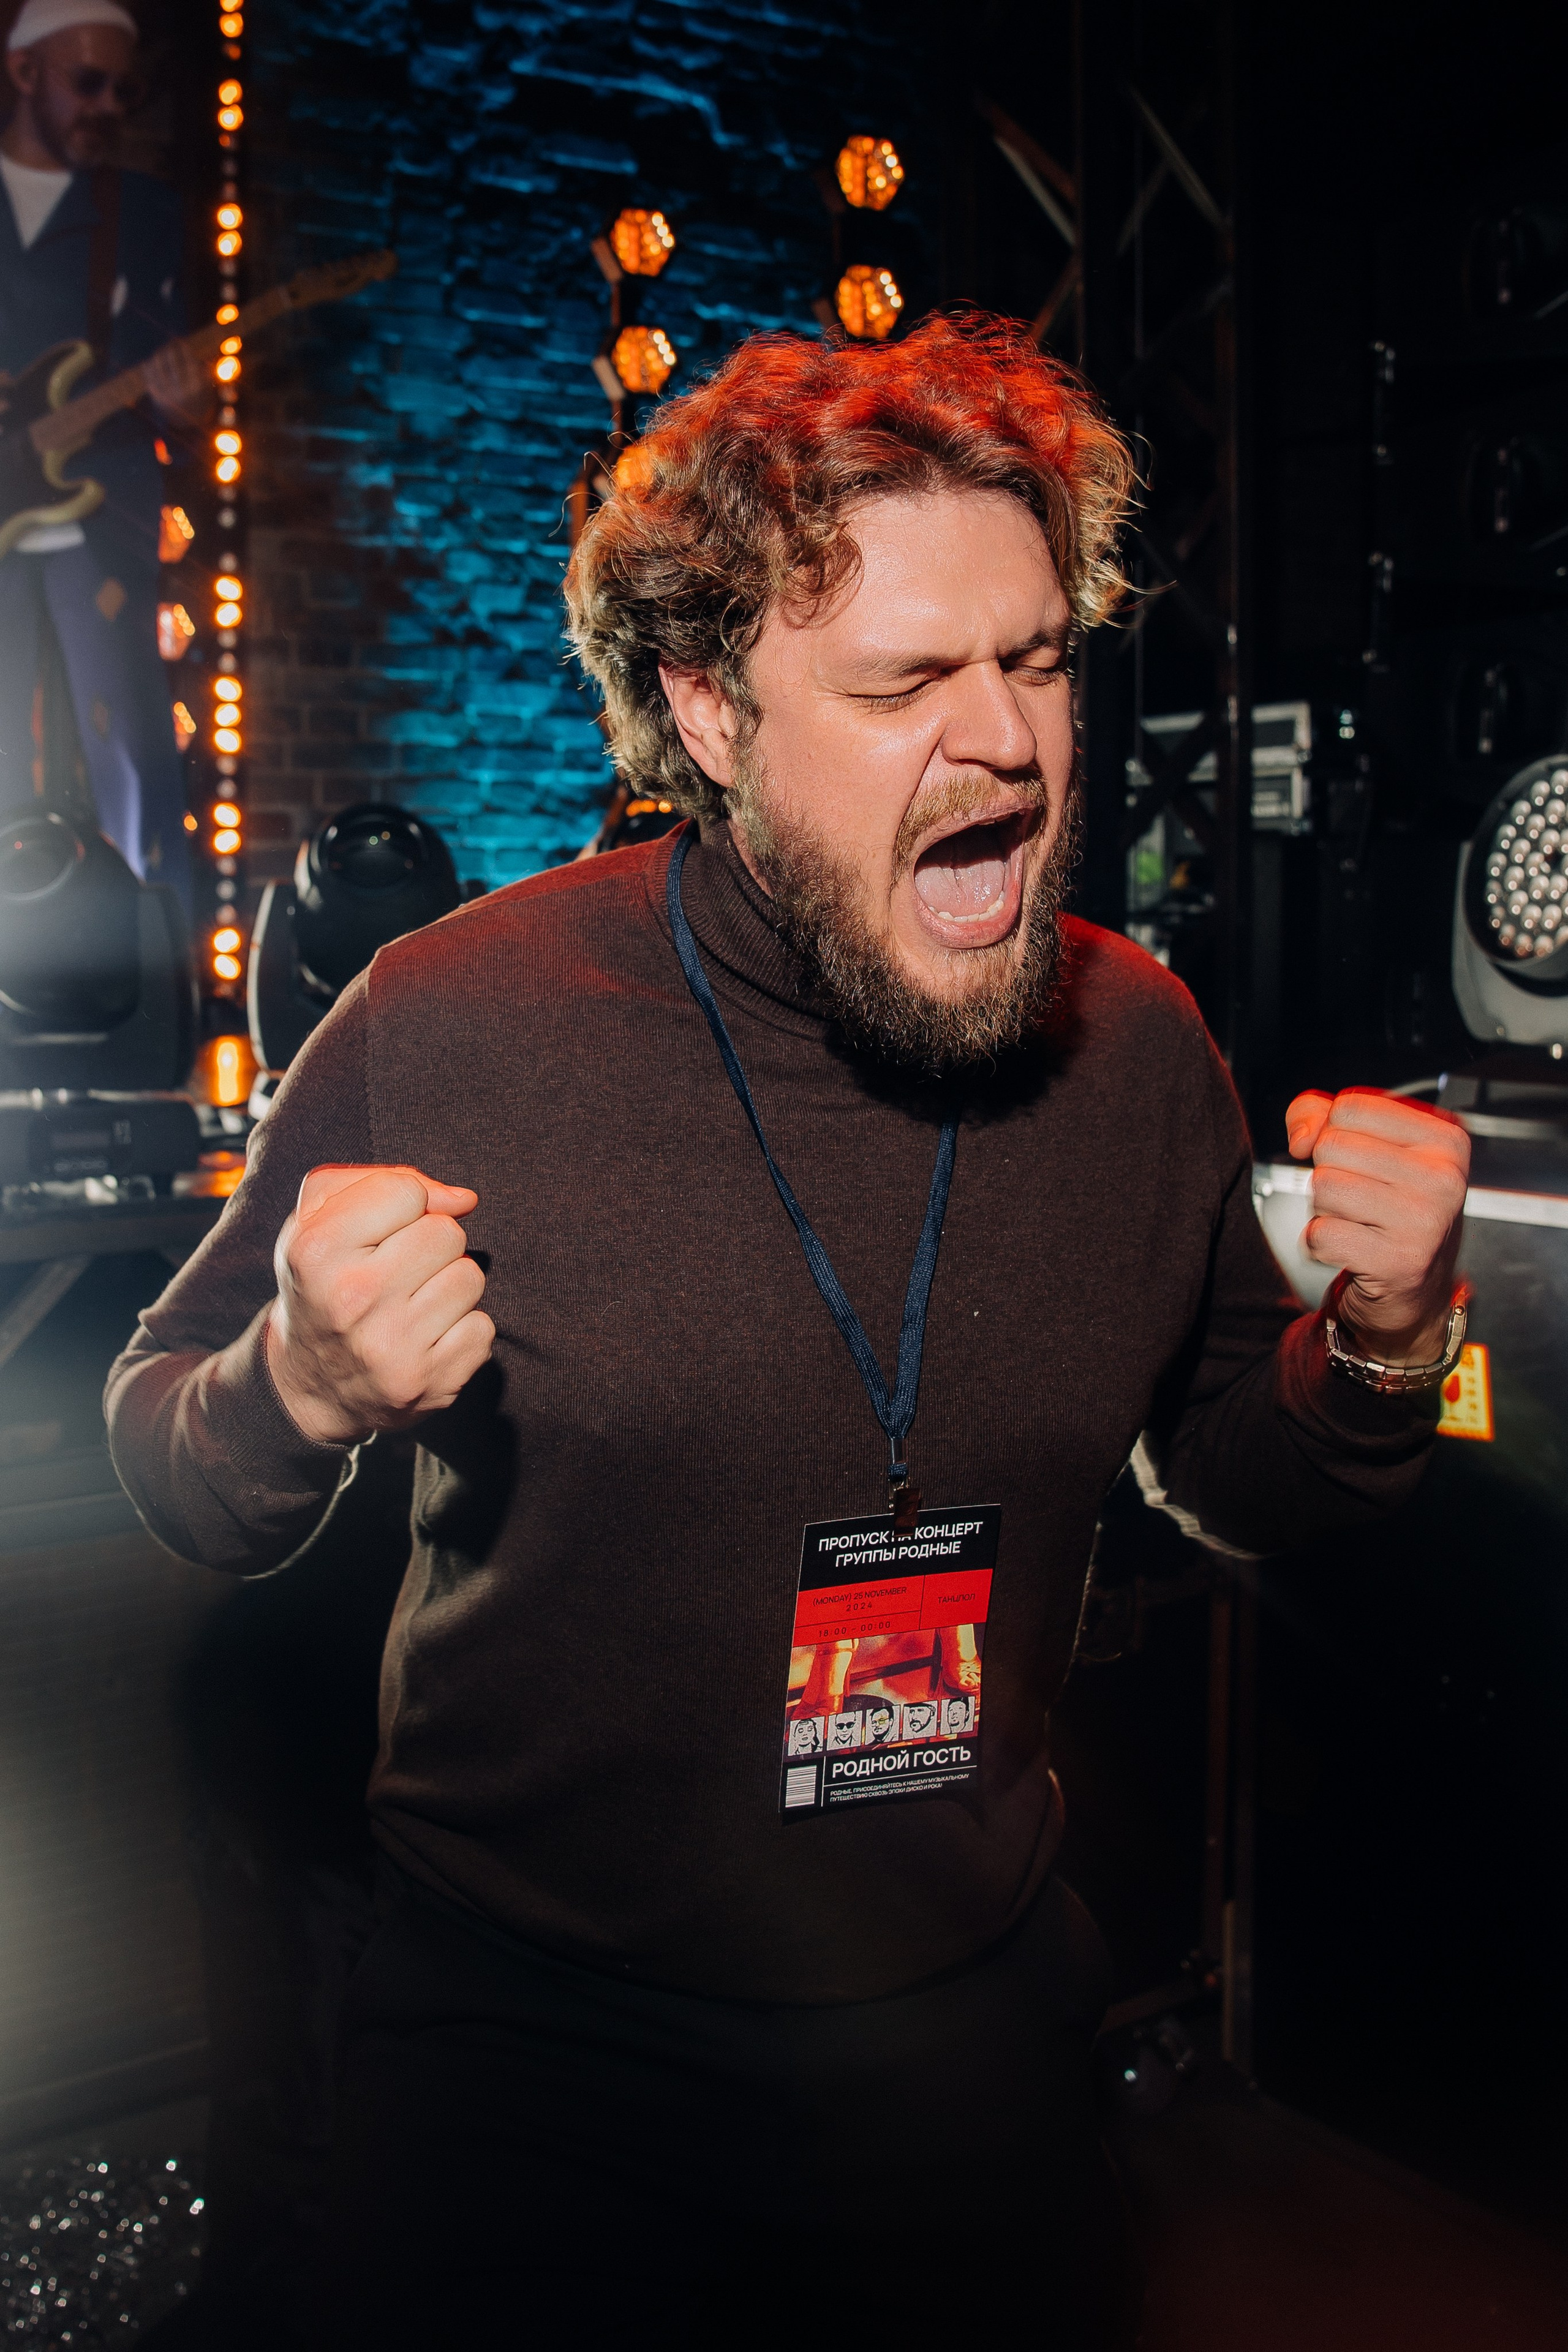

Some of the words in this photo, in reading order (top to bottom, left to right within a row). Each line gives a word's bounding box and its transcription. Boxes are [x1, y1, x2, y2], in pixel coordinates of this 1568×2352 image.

[818, 1531, 890, 1551] ПРОПУСК
[914, 1521, 984, 1540] КОНЦЕРТ
[835, 1548, 895, 1567] ГРУППЫ
[899, 1541, 961, 1559] РОДНЫЕ
[813, 1593, 851, 1607] (MONDAY)
[864, 1586, 907, 1598] NOVEMBER
[846, 1602, 872, 1611] 2024
[832, 1749, 910, 1778] РОДНОЙ
[913, 1746, 971, 1767] ГОСТЬ
